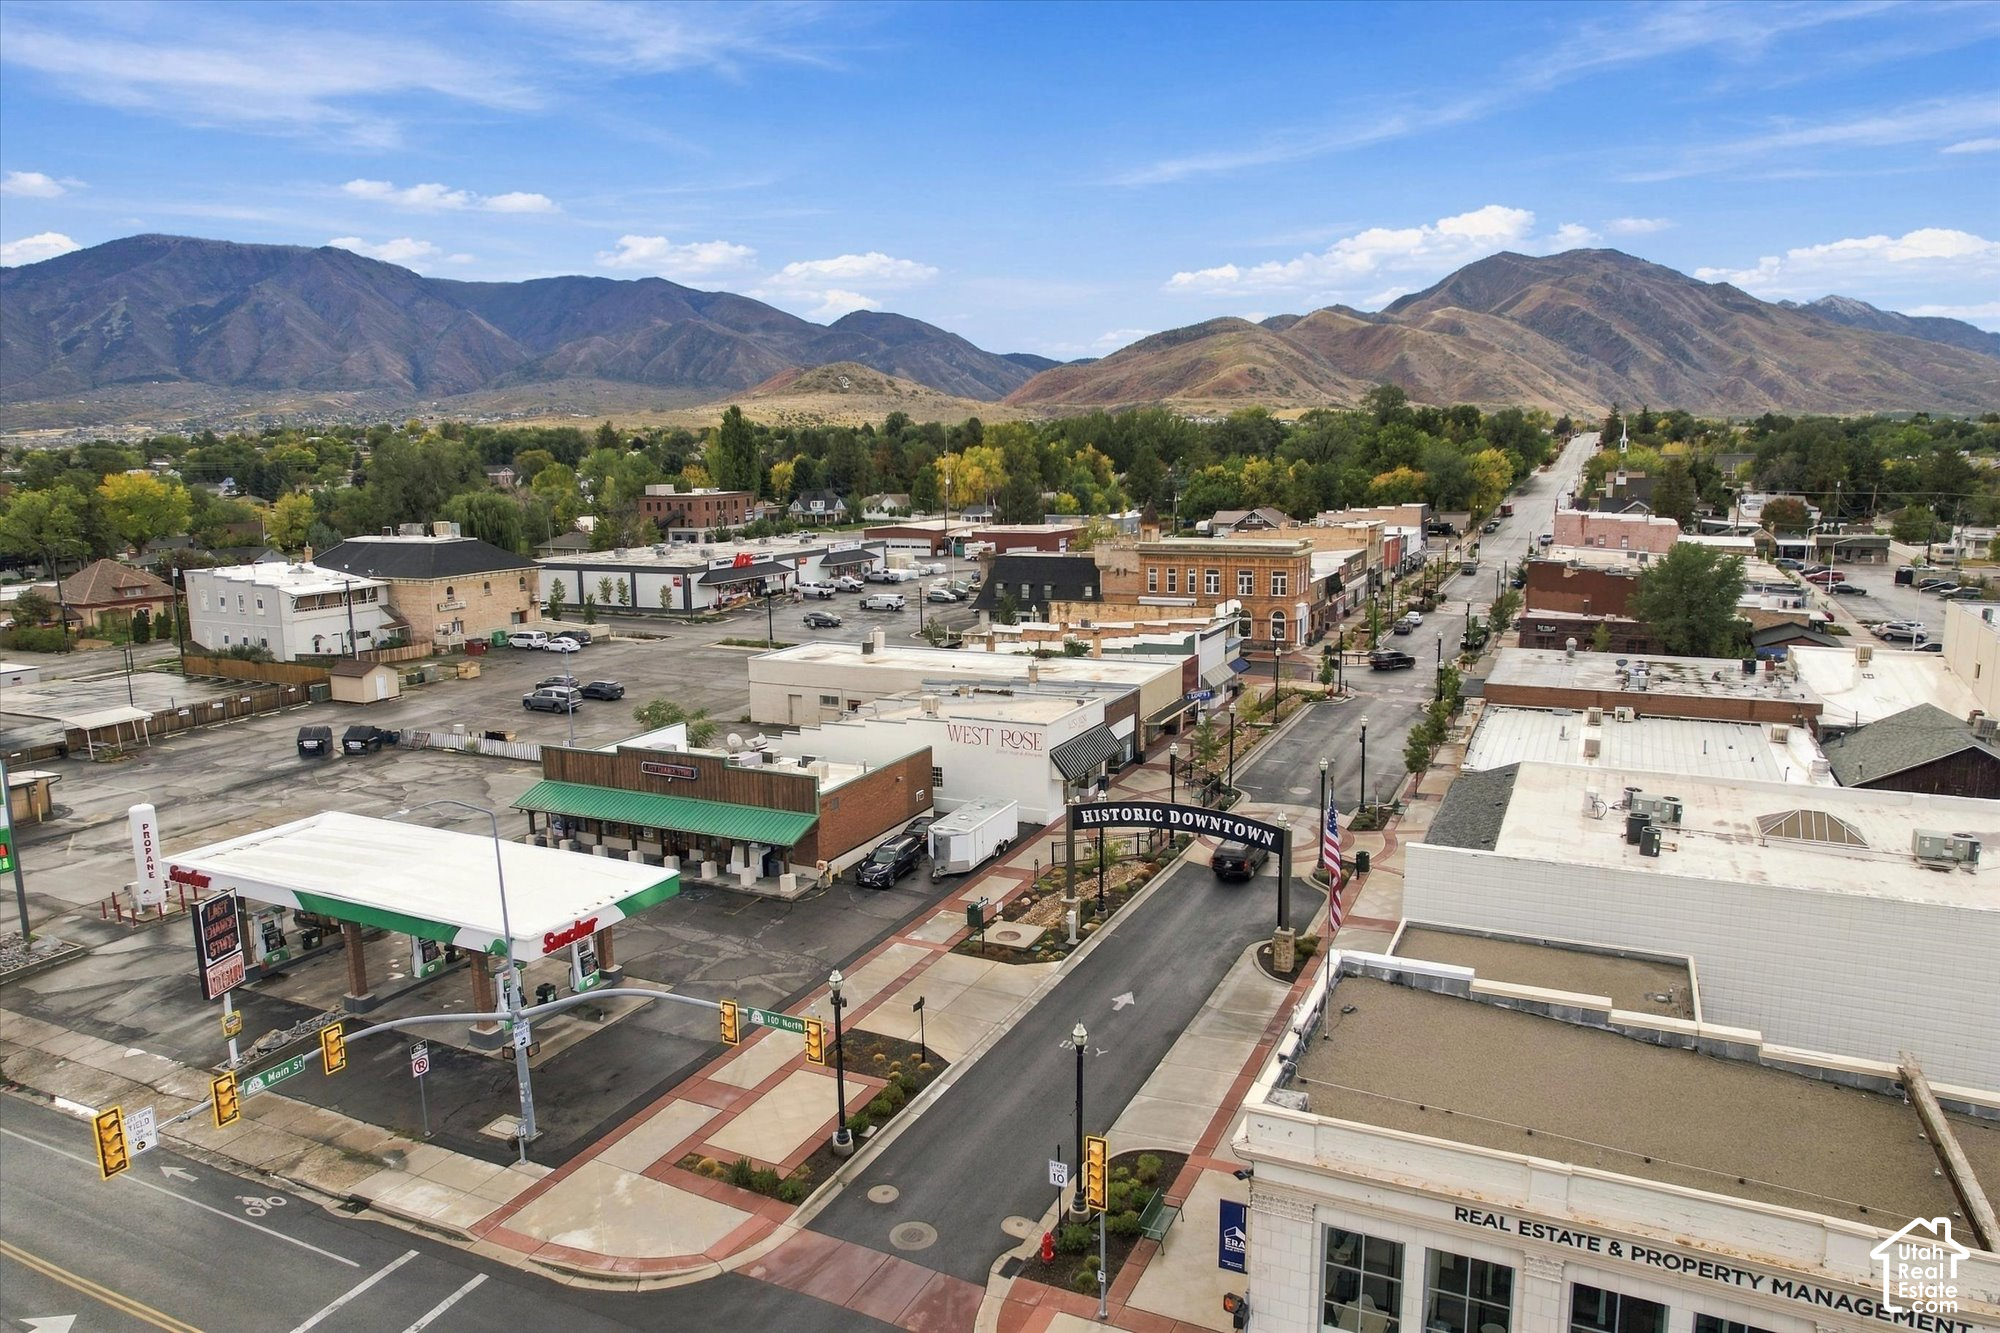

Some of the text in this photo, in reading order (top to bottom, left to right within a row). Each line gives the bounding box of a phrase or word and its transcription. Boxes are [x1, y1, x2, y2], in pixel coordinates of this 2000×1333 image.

[947, 724, 1043, 751] WEST ROSE
[1081, 808, 1275, 846] HISTORIC DOWNTOWN
[142, 823, 155, 879] PROPANE
[207, 901, 229, 921] LAST
[543, 917, 598, 953] Sinclair
[767, 1015, 779, 1025] 100
[782, 1018, 804, 1031] North
[267, 1067, 289, 1082] Main
[293, 1060, 303, 1070] St
[128, 1117, 150, 1131] YIELD
[1053, 1173, 1065, 1184] 10
[1225, 1237, 1246, 1248] ERA
[1454, 1206, 1974, 1333] REAL ESTATE & PROPERTY MANAGEMENT
